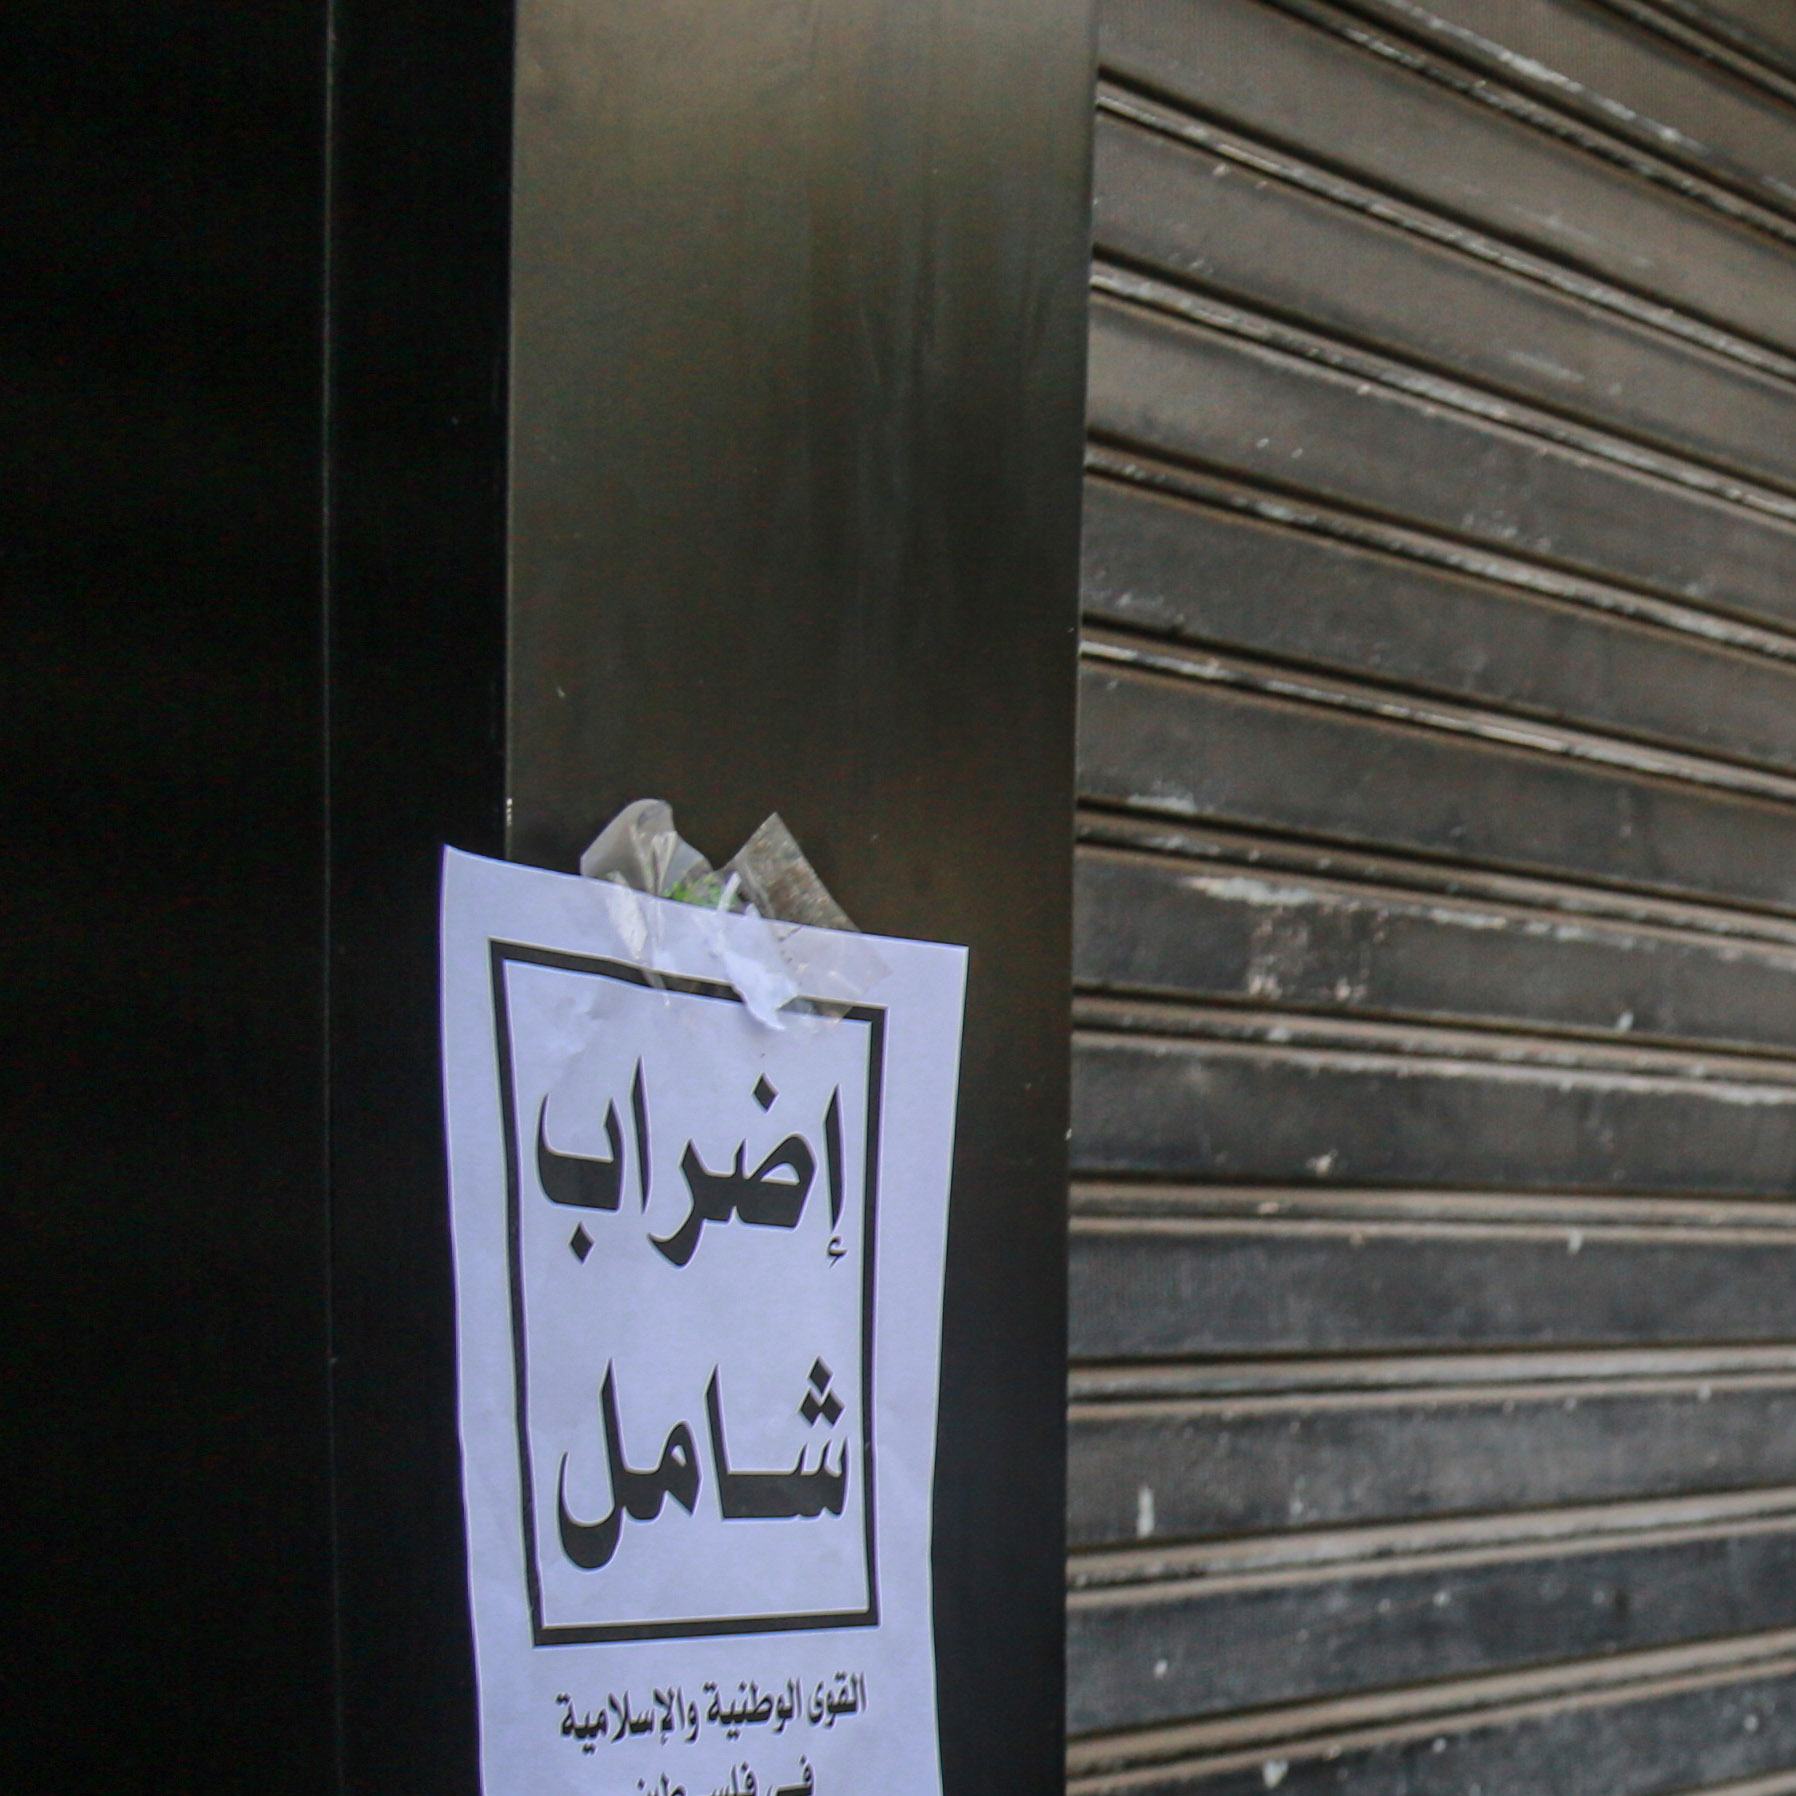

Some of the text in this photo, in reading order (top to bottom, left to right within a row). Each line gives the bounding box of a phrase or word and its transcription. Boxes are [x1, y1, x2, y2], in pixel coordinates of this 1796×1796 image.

[534, 1055, 849, 1268] إضراب
[557, 1355, 850, 1571] شامل
[555, 1670, 867, 1755] القوى الوطنية والإسلامية
